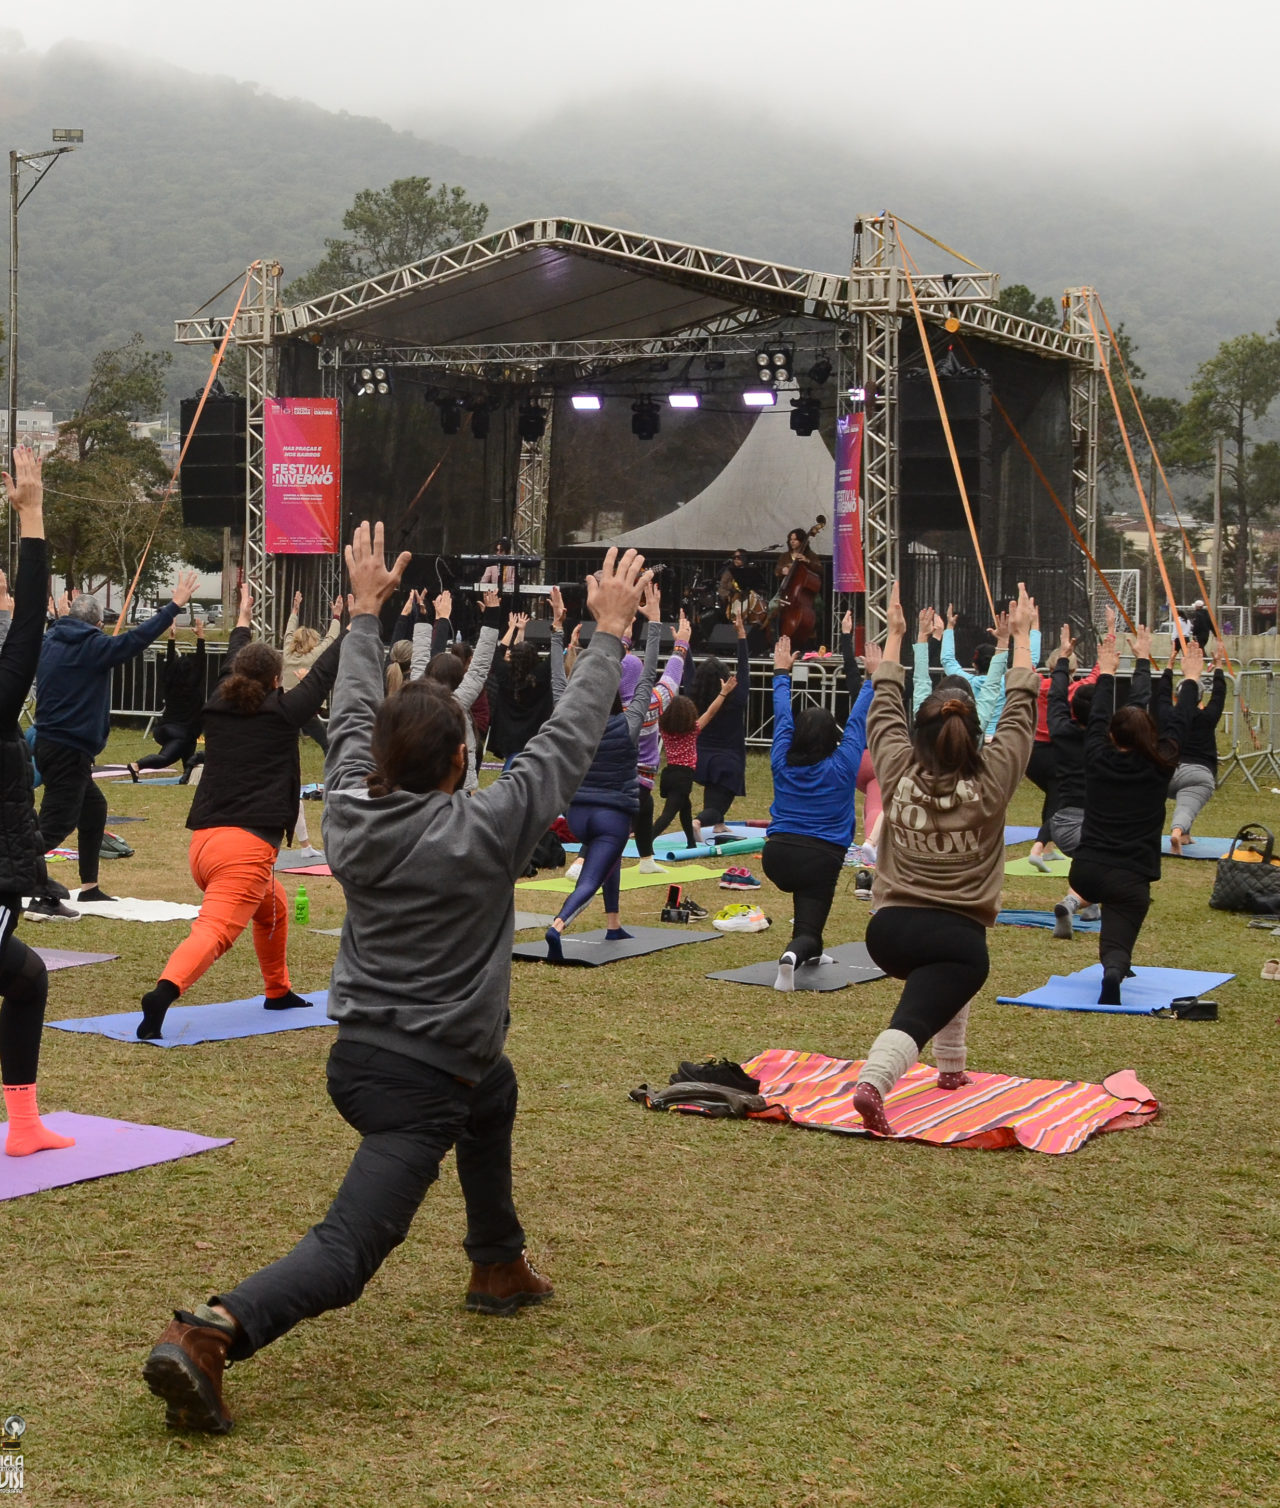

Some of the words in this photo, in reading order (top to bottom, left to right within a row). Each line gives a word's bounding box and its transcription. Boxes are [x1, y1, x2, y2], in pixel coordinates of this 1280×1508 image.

[272, 464, 333, 475] FESTIVAL
[276, 474, 333, 485] INVERNO
[890, 799, 928, 830] TO
